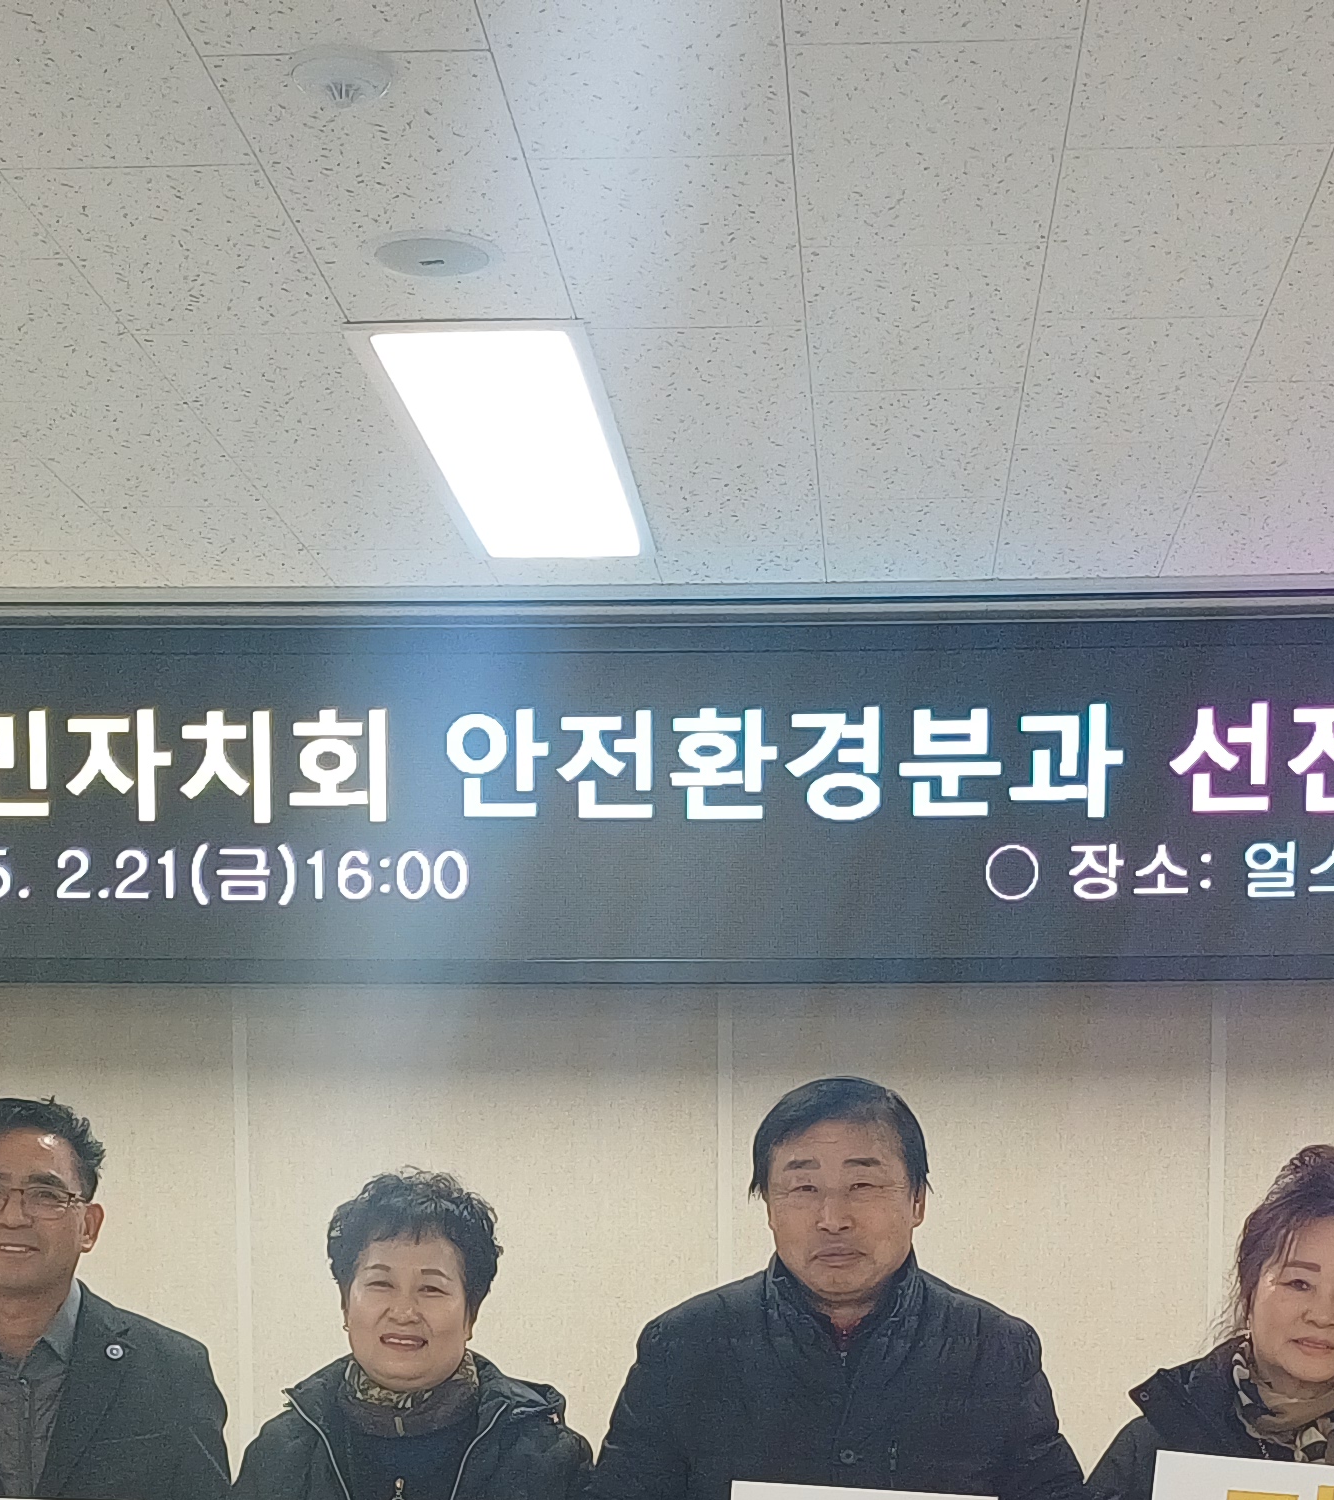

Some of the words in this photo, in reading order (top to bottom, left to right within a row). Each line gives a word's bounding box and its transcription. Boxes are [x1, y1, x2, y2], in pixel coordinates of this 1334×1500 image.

[445, 702, 1125, 822] 안전환경분과
[55, 841, 471, 907] 2.21(금)16:00
[1067, 842, 1213, 901] 장소:
